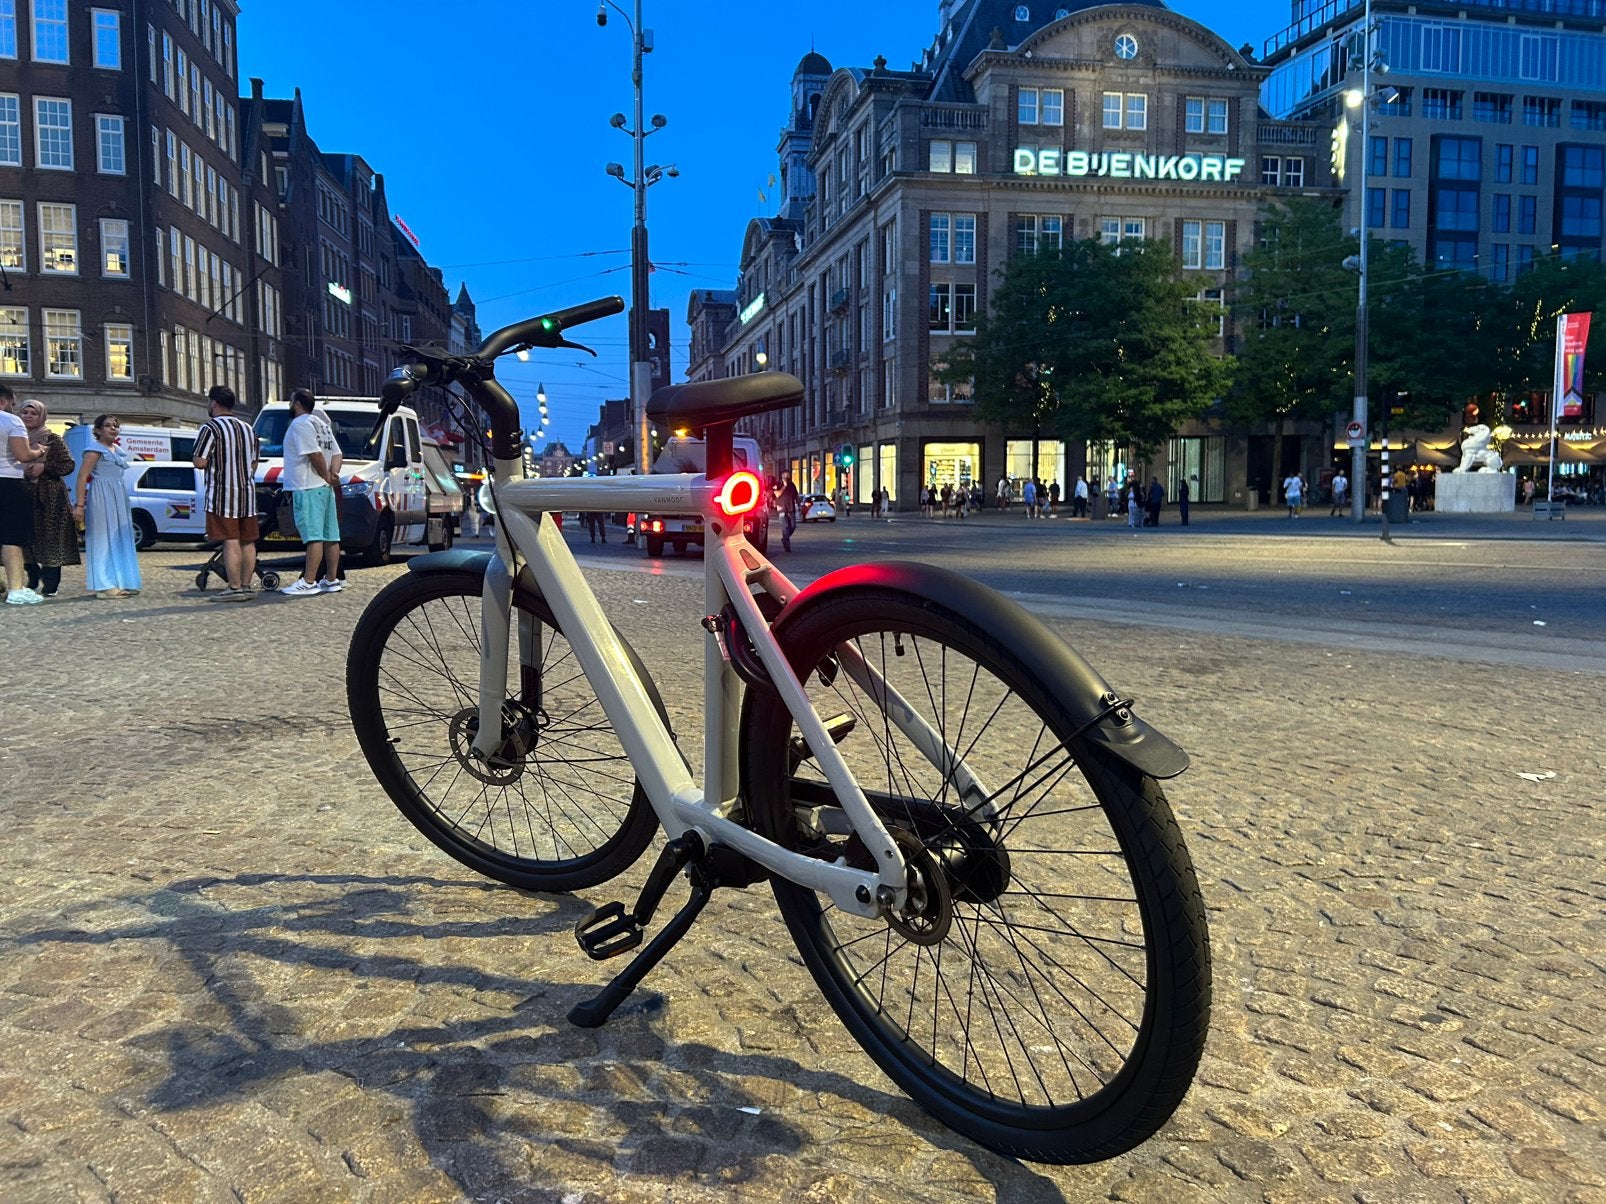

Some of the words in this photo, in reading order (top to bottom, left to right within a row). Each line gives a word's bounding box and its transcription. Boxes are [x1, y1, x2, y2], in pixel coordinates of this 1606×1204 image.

[1013, 149, 1060, 176] DE
[1066, 150, 1246, 182] BIJENKORF
[126, 437, 164, 446] Gemeente
[127, 445, 170, 453] Amsterdam
